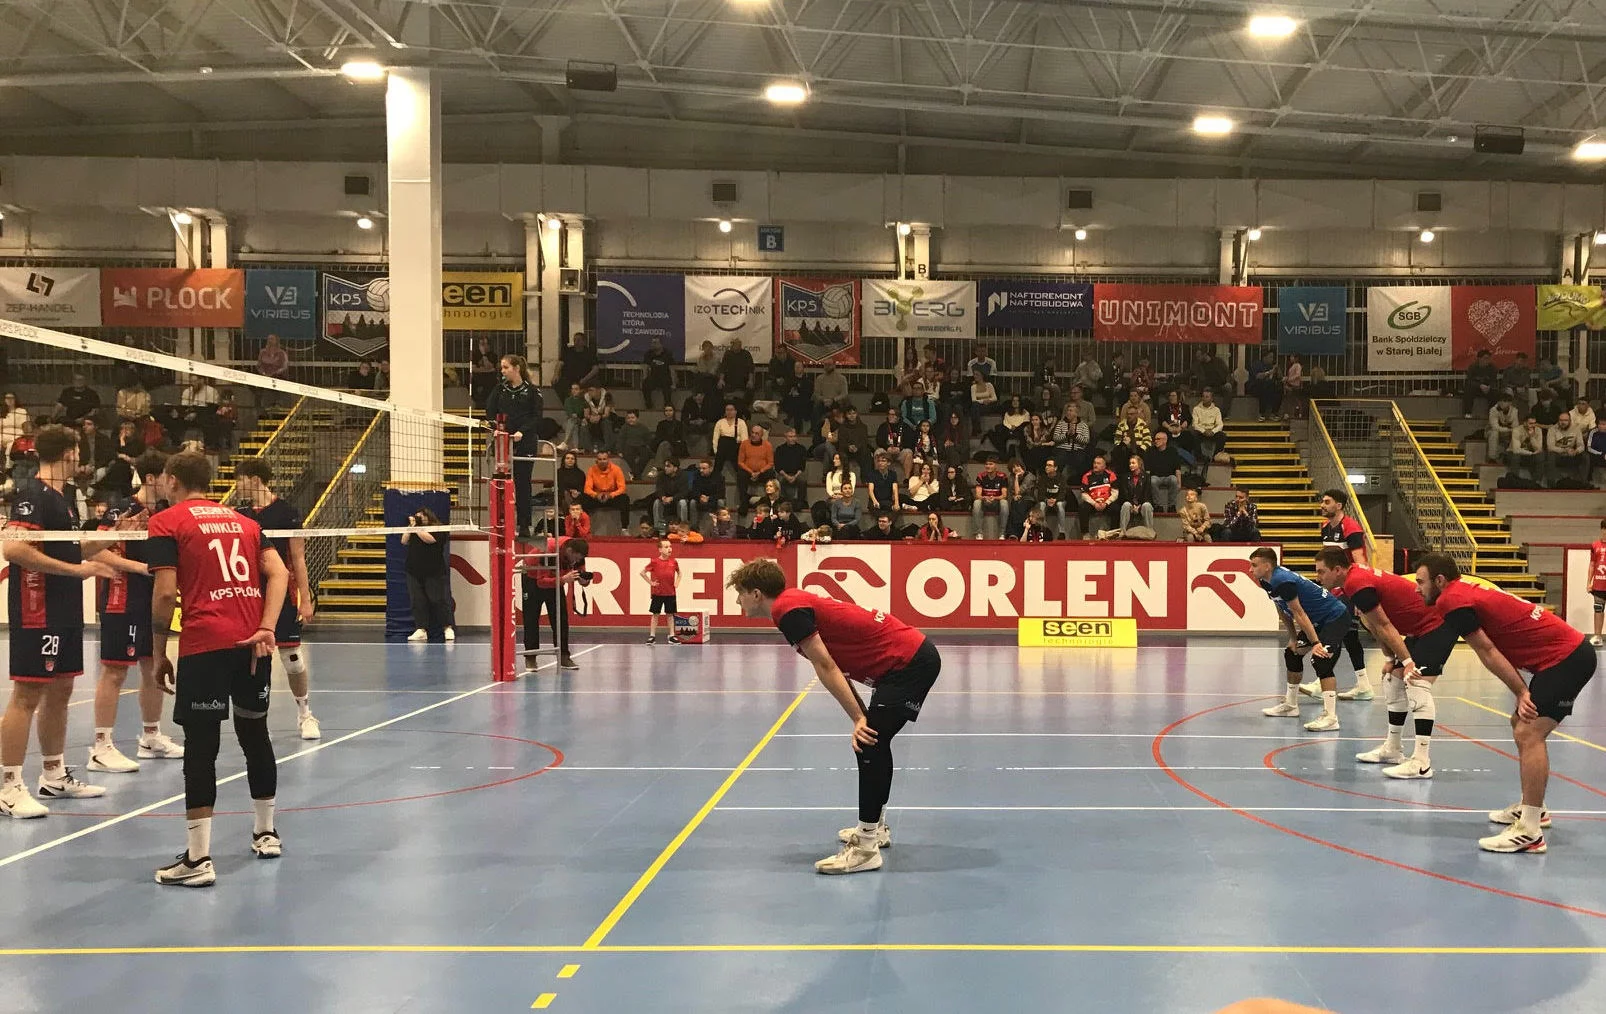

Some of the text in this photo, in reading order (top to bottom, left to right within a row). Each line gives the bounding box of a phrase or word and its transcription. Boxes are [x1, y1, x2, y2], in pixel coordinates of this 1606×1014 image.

[767, 235, 776, 249] B
[918, 264, 926, 274] B
[1563, 268, 1572, 278] A
[147, 287, 232, 310] PŁOCK
[330, 293, 361, 305] KPS
[443, 284, 508, 304] een
[1010, 292, 1083, 300] NAFTOREMONT
[787, 300, 816, 312] KPS
[1010, 300, 1084, 308] NAFTOBUDOWA
[251, 309, 310, 319] VIRIBUS
[443, 309, 512, 320] hnologie
[694, 305, 765, 316] IZOTECHNIK
[1099, 300, 1258, 328] UNIMONT
[1398, 312, 1421, 321] SGB
[1284, 325, 1341, 335] VIRIBUS
[1372, 335, 1447, 345] Bank Spółdzielczy
[1386, 347, 1413, 358] Starej
[1416, 347, 1442, 358] Białej
[208, 538, 250, 582] 16
[209, 586, 261, 601] KPS PŁOK
[906, 557, 1168, 618] ORLEN
[128, 625, 136, 642] 4
[1044, 621, 1110, 636] seen
[42, 635, 59, 655] 28
